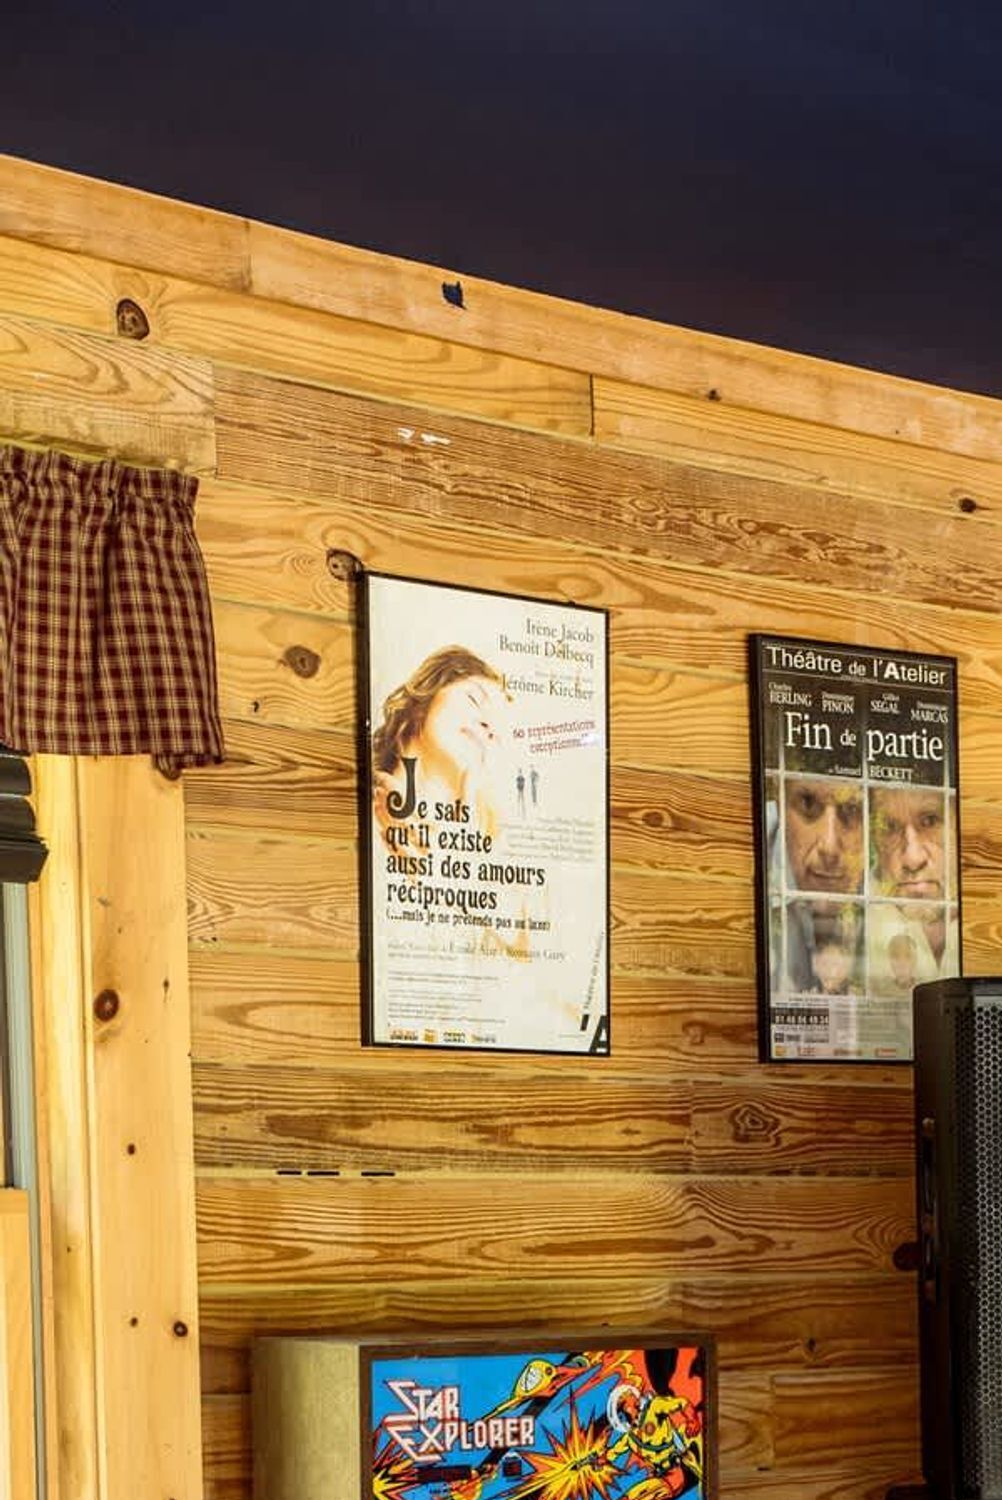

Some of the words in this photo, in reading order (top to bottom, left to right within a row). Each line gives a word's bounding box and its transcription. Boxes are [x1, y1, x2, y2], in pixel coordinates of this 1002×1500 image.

[558, 621, 594, 644] Jacob
[767, 646, 842, 673] Théâtre
[848, 660, 866, 677] de
[873, 658, 947, 685] l'Atelier
[769, 689, 812, 707] BERLING
[821, 700, 855, 715] PINON
[784, 711, 834, 751] Fin
[840, 728, 857, 747] de
[866, 728, 944, 761] partie
[869, 765, 914, 780] BECKETT
[386, 757, 428, 819] Je
[435, 799, 471, 822] sais
[439, 829, 492, 853] existe
[386, 854, 433, 876] aussi
[441, 856, 471, 879] des
[478, 863, 545, 885] amours
[386, 881, 498, 914] réciproques
[384, 1380, 459, 1420] STAR
[384, 1415, 536, 1461] EXPLORER
